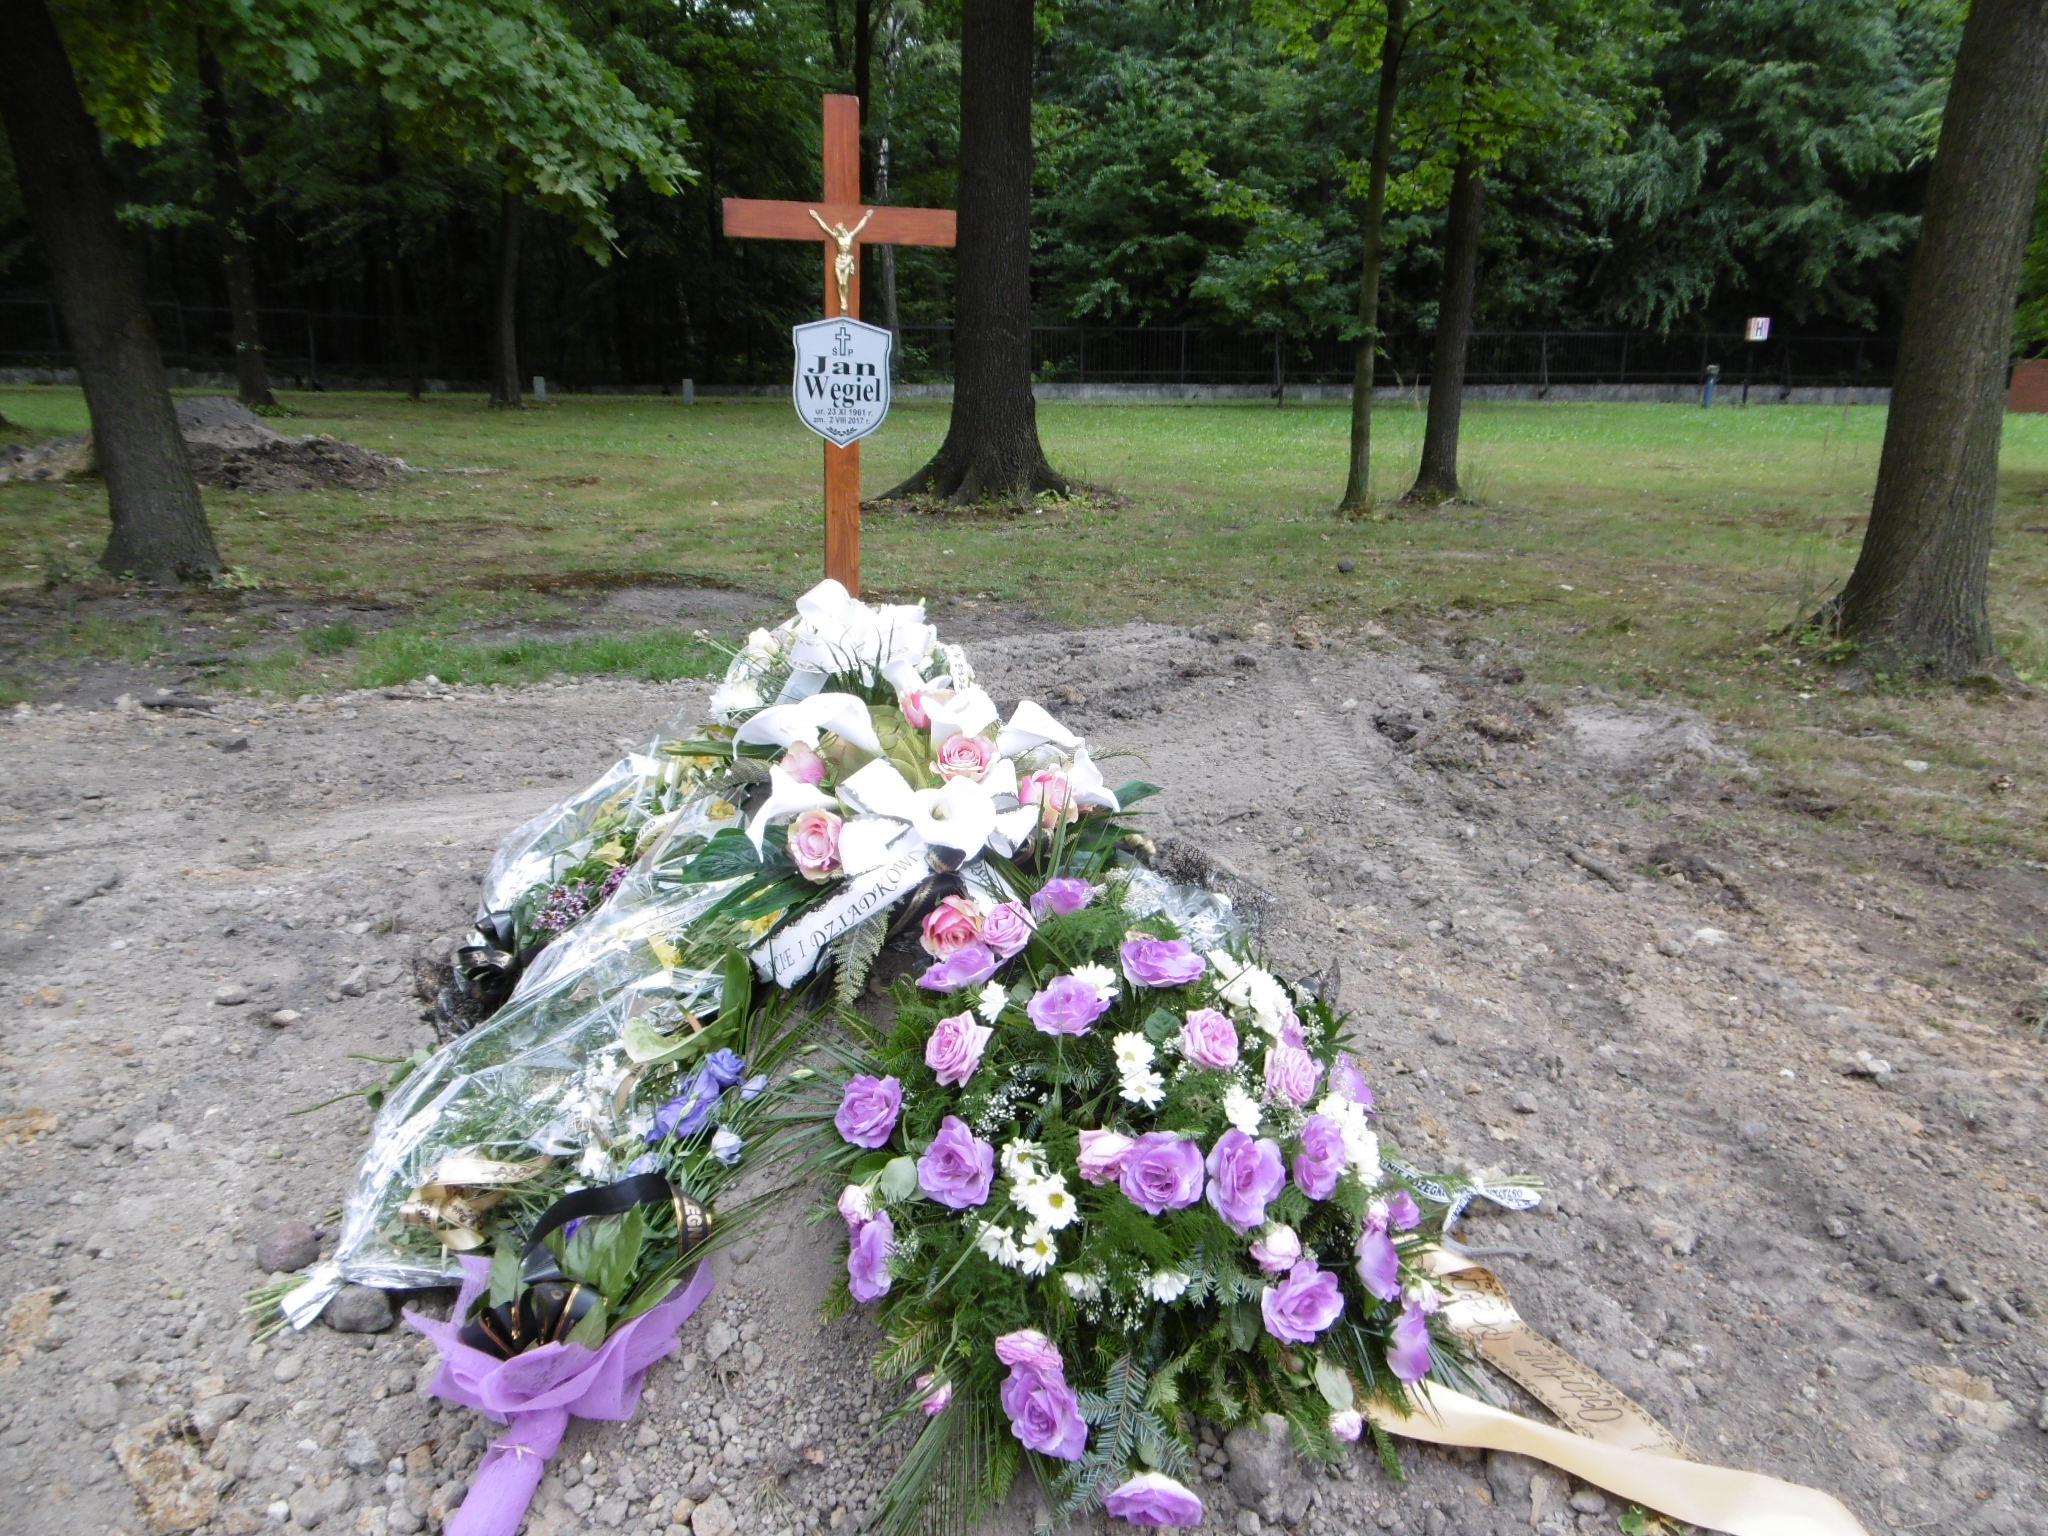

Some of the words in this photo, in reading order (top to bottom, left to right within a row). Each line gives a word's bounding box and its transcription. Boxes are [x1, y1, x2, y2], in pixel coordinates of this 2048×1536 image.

[848, 348, 854, 357] P
[807, 355, 876, 377] Jan
[803, 375, 881, 409] Węgiel
[815, 408, 826, 416] ur.
[828, 407, 836, 416] 23
[838, 408, 847, 416] XI
[848, 417, 864, 425] 2017
[797, 940, 808, 959] I
[810, 855, 919, 949] DZIADKOWI
